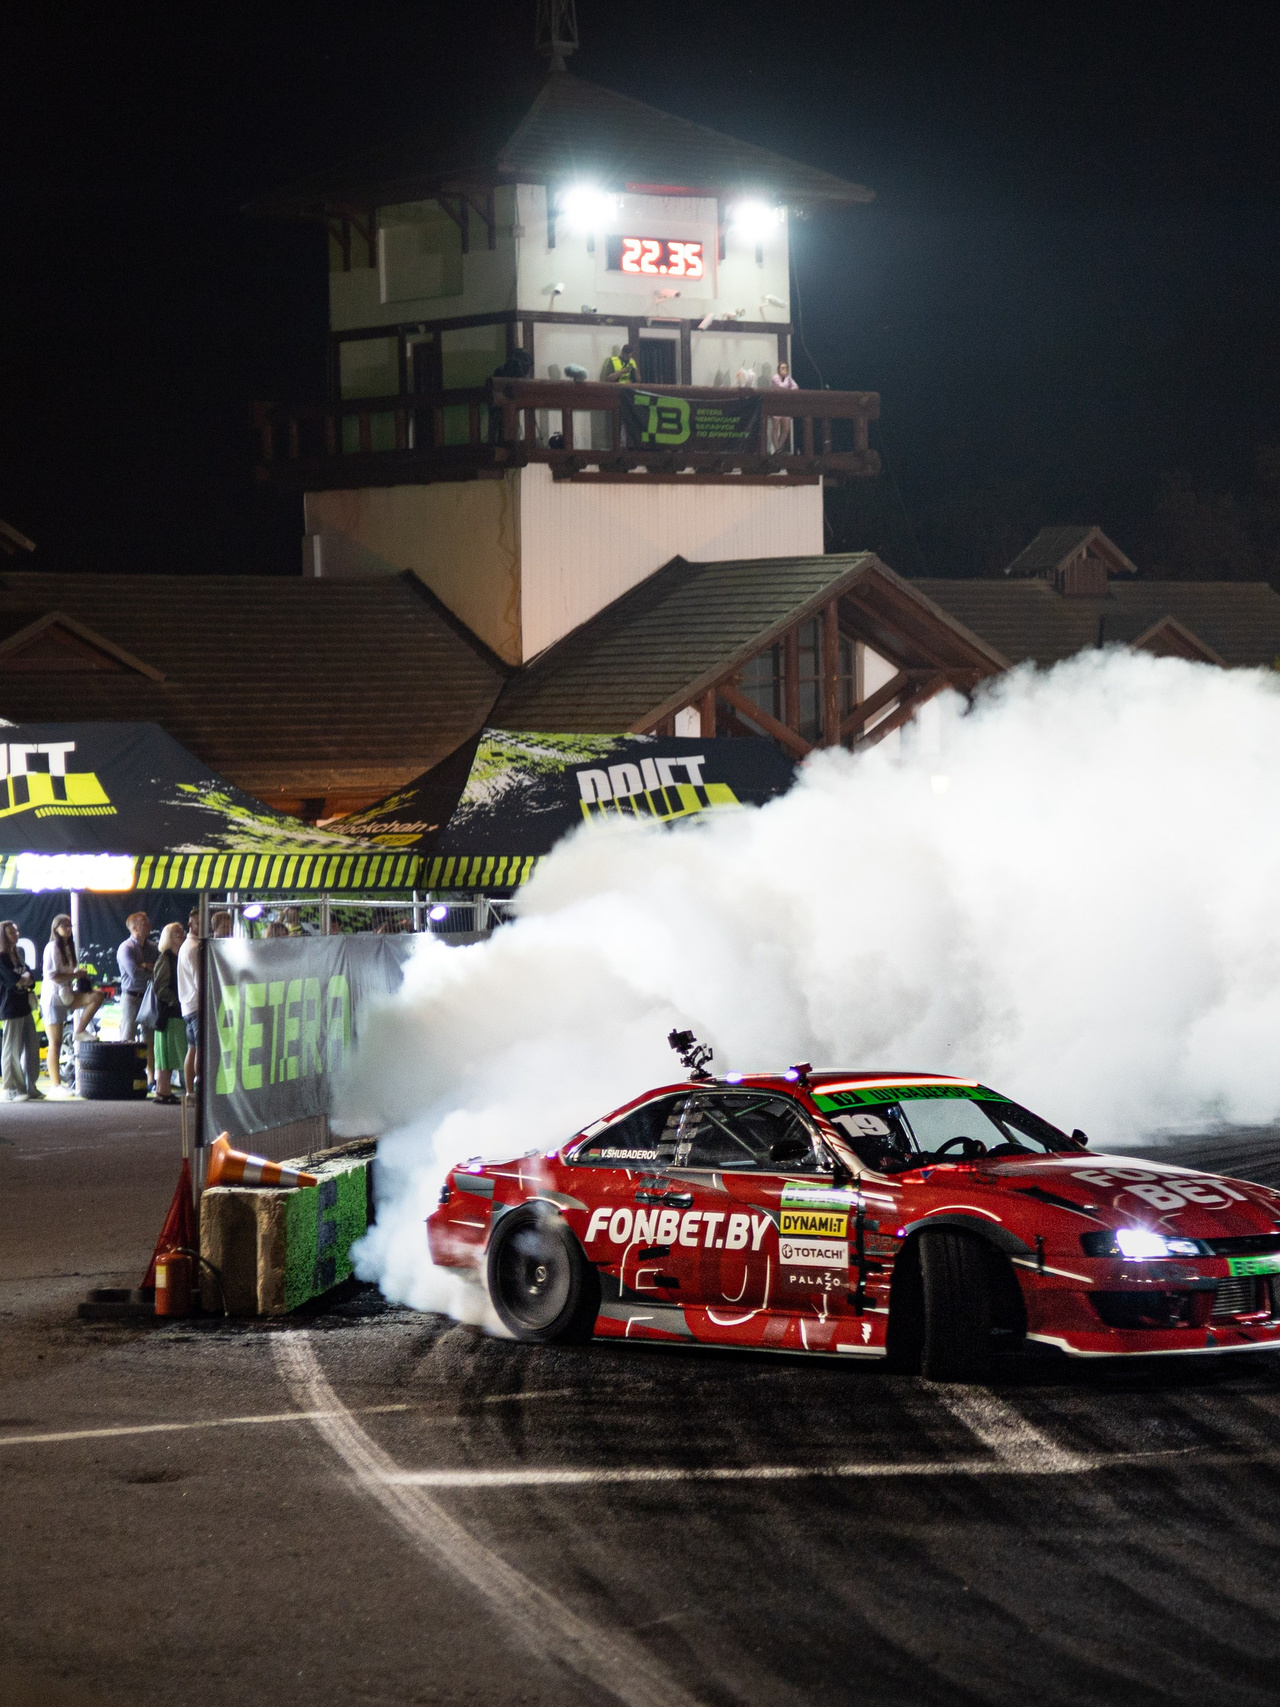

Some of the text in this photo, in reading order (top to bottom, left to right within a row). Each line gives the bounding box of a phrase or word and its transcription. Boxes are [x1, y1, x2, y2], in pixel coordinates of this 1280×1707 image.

[622, 237, 703, 277] 22.35
[576, 755, 711, 818] DRIFT
[215, 974, 352, 1095] BETERA
[832, 1092, 856, 1105] 19
[830, 1114, 890, 1137] 19
[601, 1149, 659, 1160] V.SHUBADEROV
[1122, 1179, 1249, 1211] BET
[584, 1207, 772, 1251] FONBET.BY
[794, 1247, 843, 1259] TOTACHI
